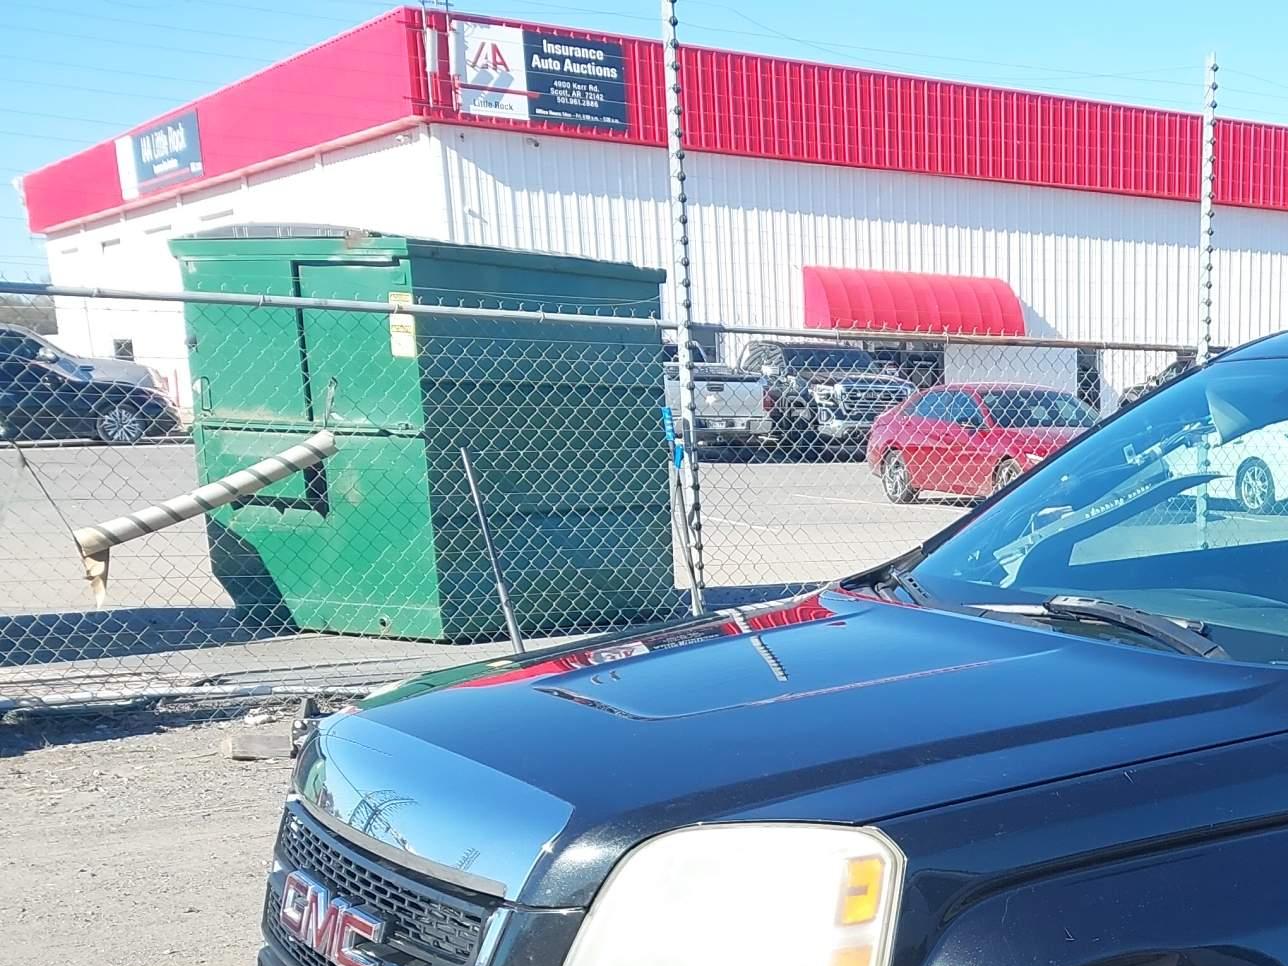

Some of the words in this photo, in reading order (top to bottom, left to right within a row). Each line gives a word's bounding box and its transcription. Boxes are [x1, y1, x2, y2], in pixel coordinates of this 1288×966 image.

[543, 39, 604, 61] Insurance
[531, 54, 561, 72] Auto
[563, 60, 618, 79] Auctions
[473, 98, 493, 109] Little
[494, 100, 514, 111] Rock
